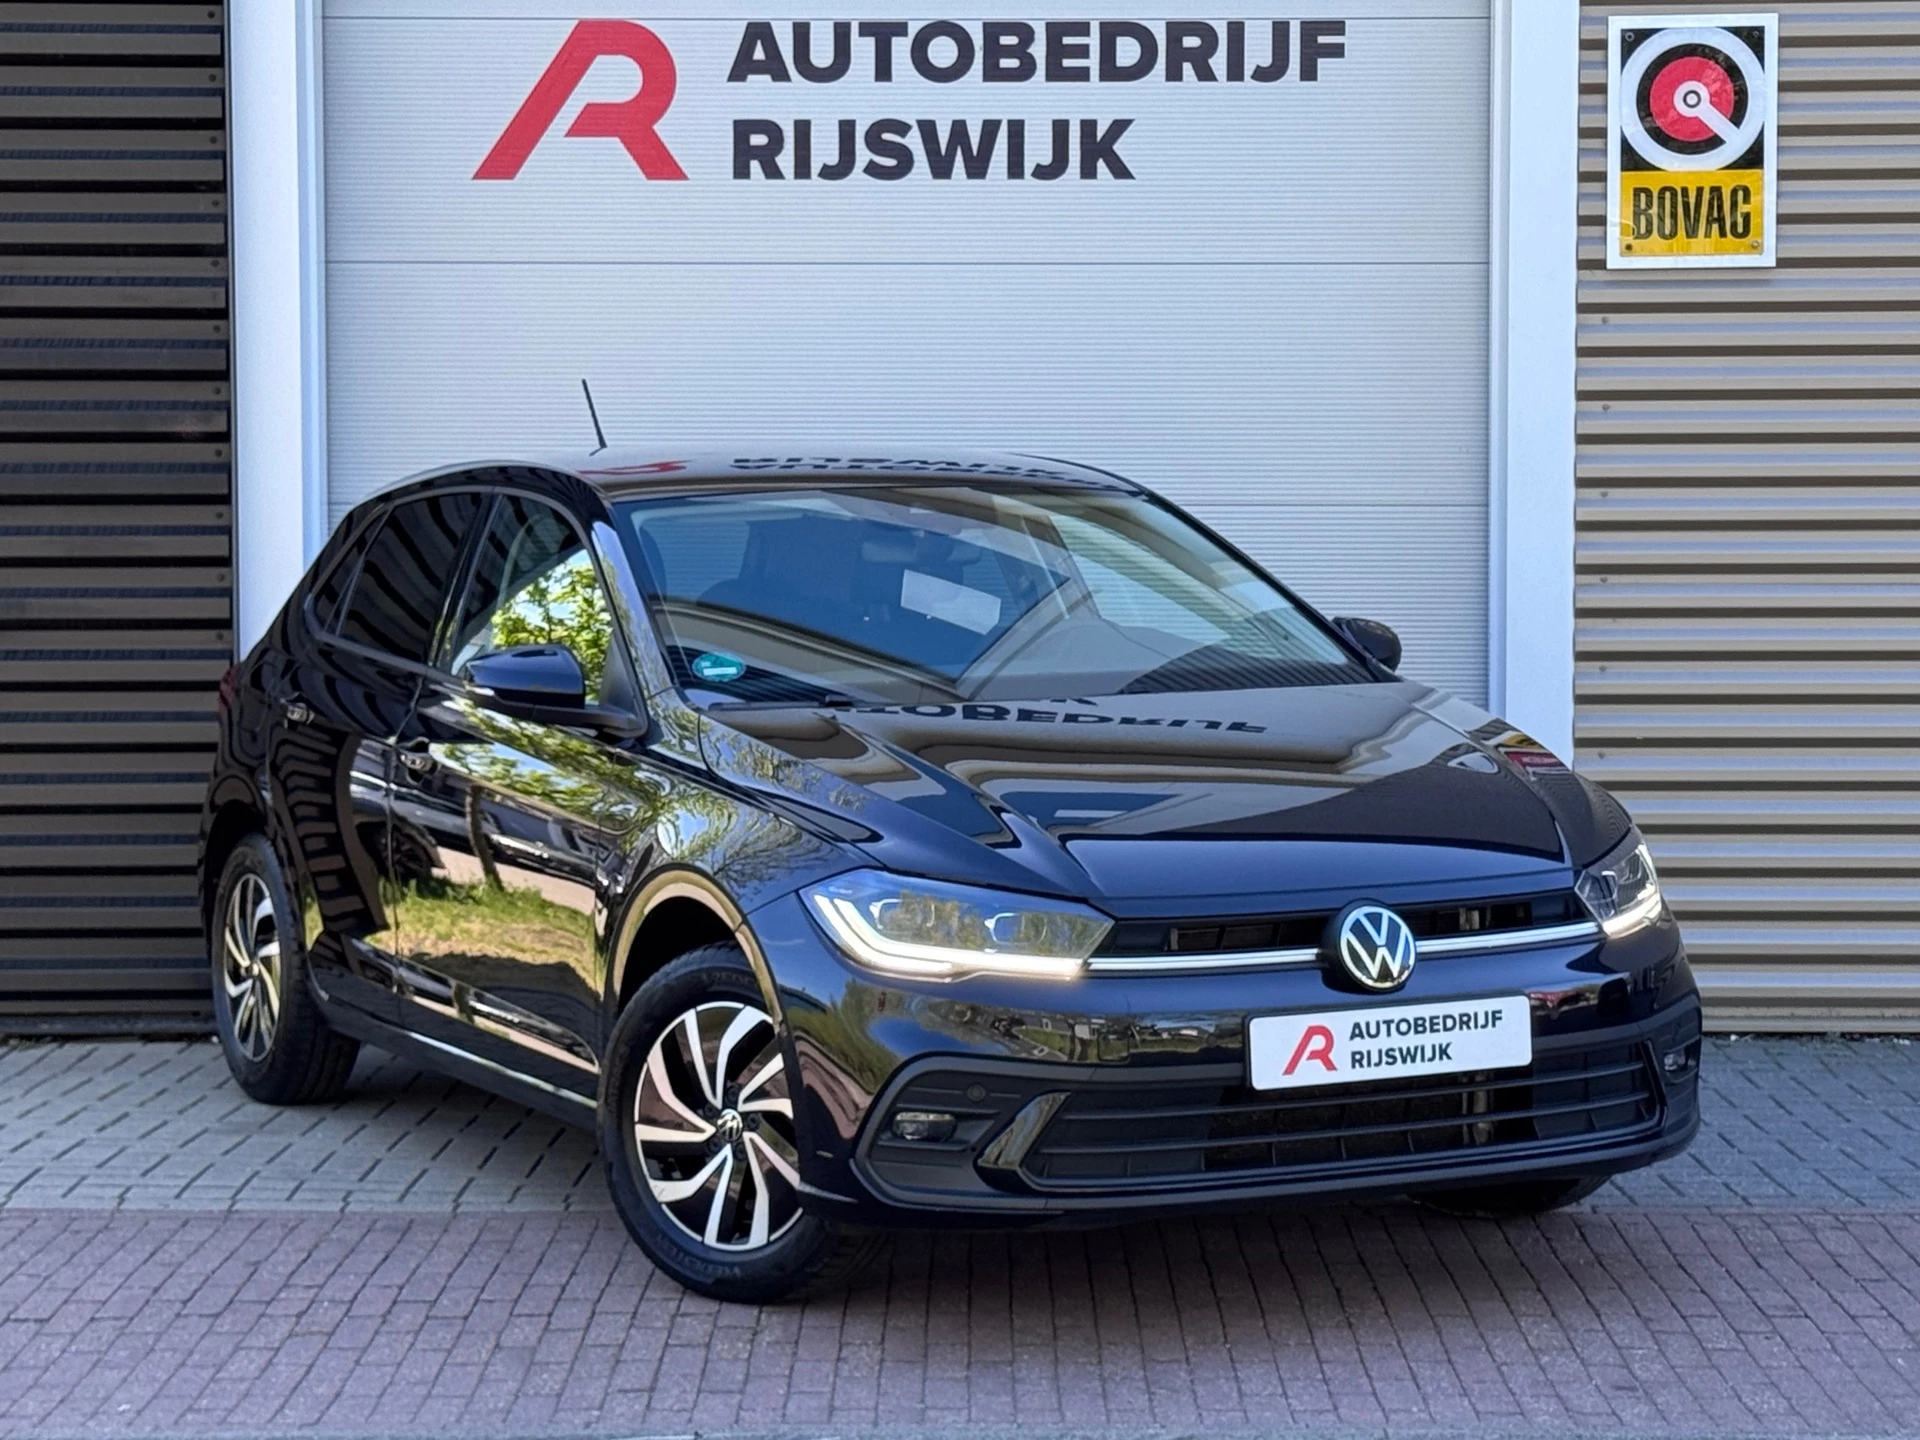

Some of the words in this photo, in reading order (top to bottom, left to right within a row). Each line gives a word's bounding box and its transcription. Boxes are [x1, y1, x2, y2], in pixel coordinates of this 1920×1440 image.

[727, 20, 1347, 84] AUTOBEDRIJF
[732, 118, 1136, 181] RIJSWIJK
[1632, 185, 1752, 240] BOVAG
[1349, 1009, 1504, 1041] AUTOBEDRIJF
[1350, 1042, 1453, 1070] RIJSWIJK
